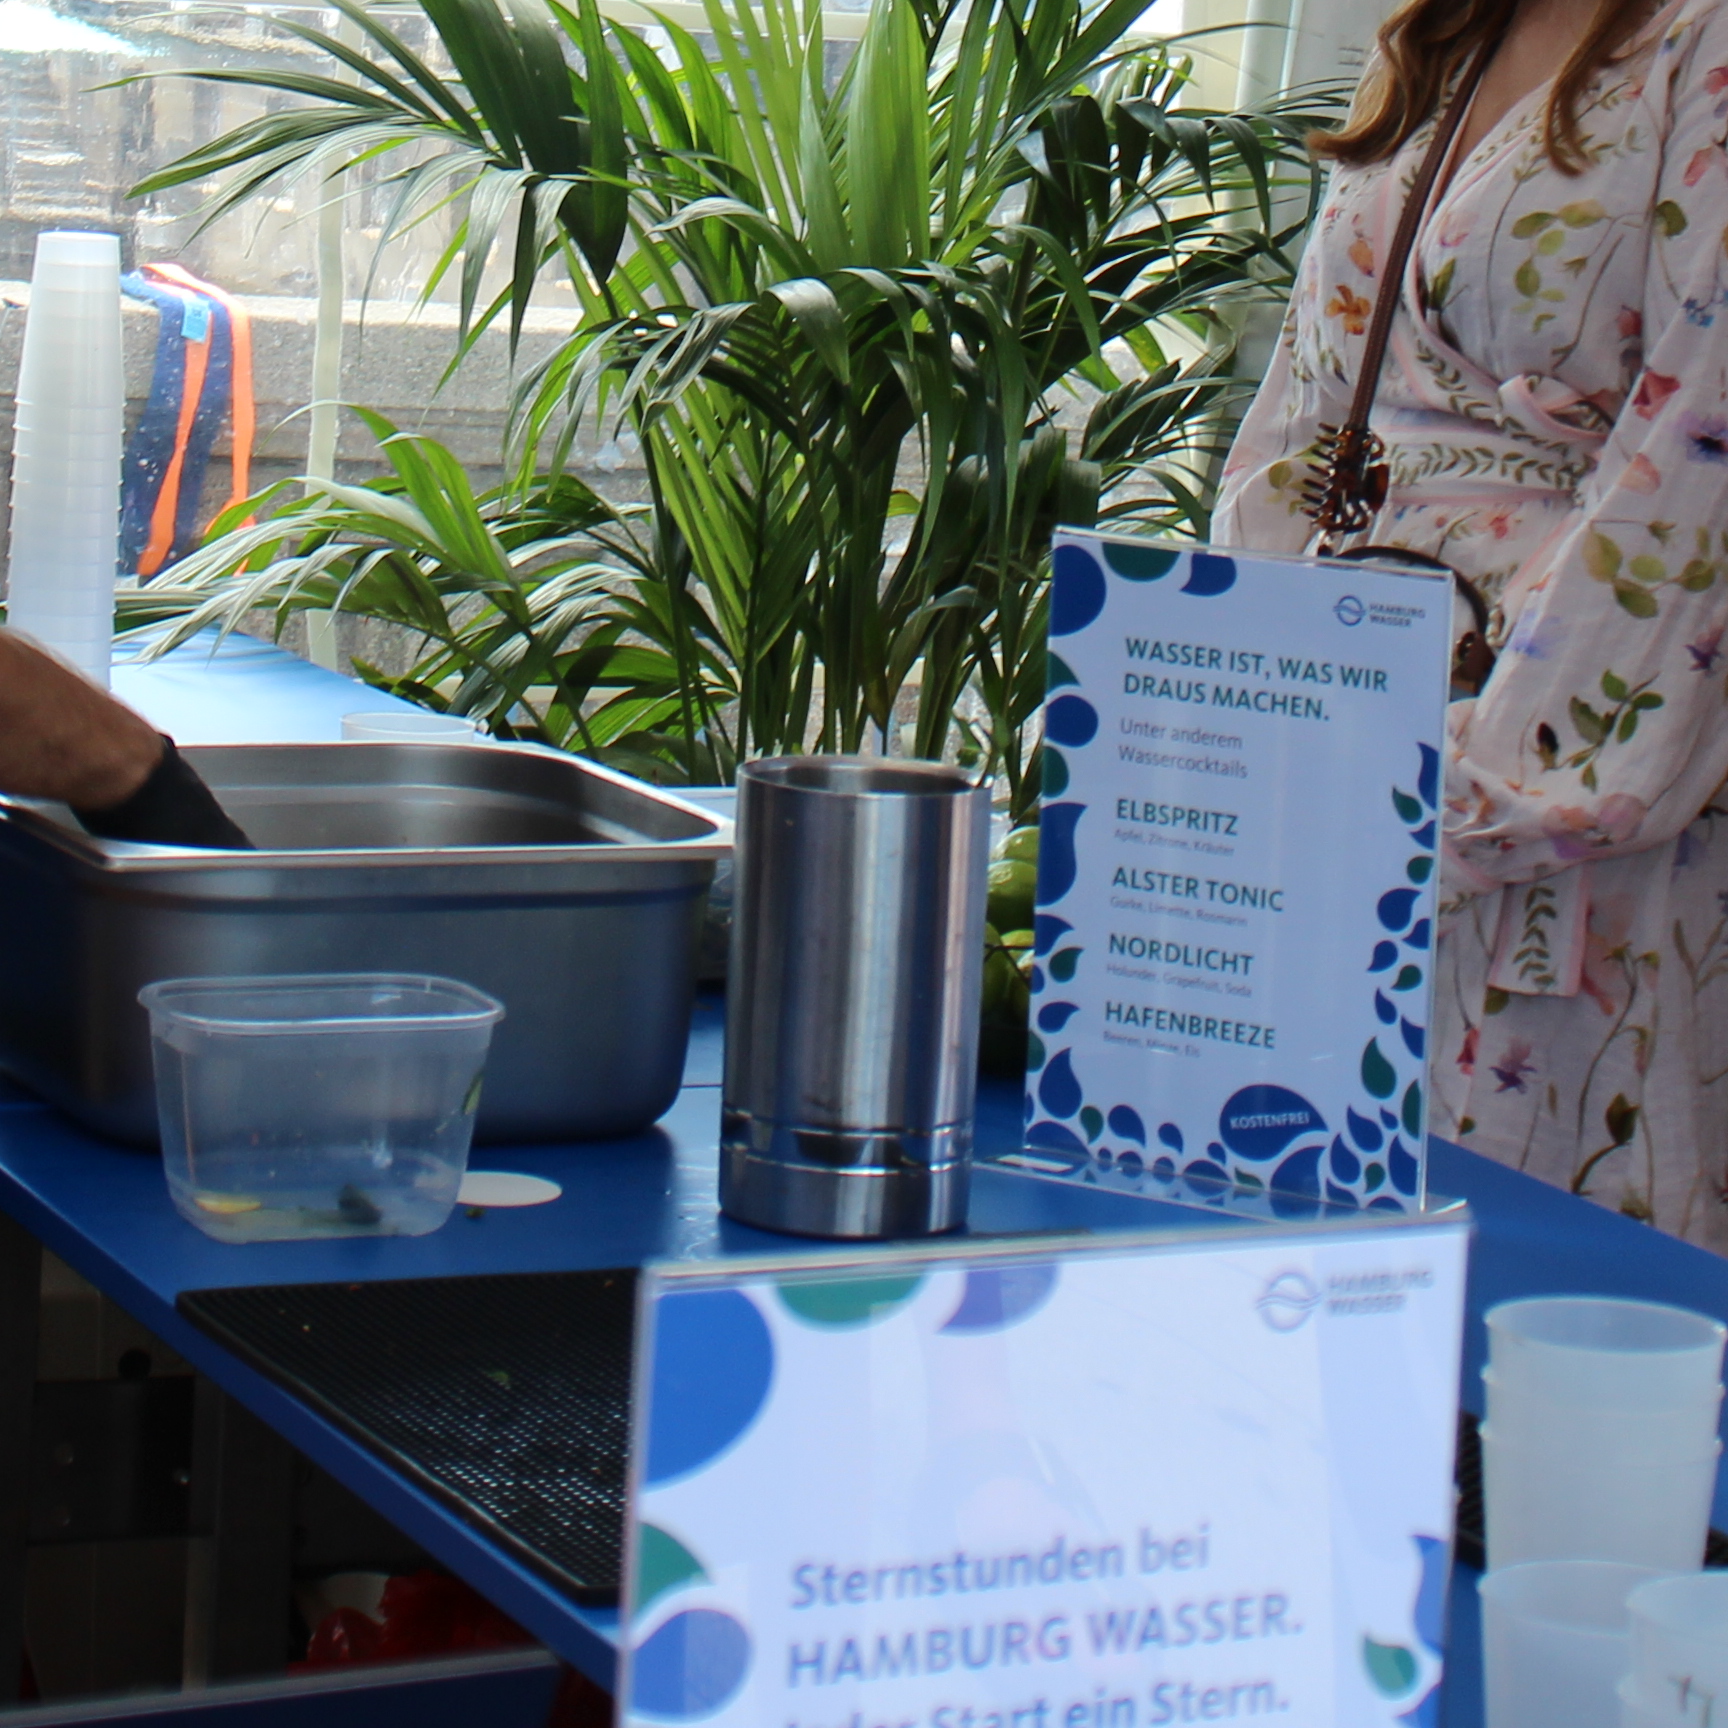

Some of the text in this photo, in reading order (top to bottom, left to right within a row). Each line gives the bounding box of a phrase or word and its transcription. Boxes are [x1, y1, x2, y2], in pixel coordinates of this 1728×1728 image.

[1125, 637, 1388, 692] WASSER IST, WAS WIR
[1124, 673, 1330, 721] DRAUS MACHEN.
[1120, 718, 1243, 749] Unter anderem
[1118, 745, 1249, 779] Wassercocktails
[1116, 798, 1238, 836] ELBSPRITZ
[1112, 867, 1284, 912] ALSTER TONIC
[1109, 933, 1255, 975] NORDLICHT
[1105, 1000, 1276, 1049] HAFENBREEZE
[1229, 1111, 1310, 1129] KOSTENFREI
[789, 1522, 1212, 1611] Sternstunden bei
[787, 1591, 1304, 1690] HAMBURG WASSER.
[1065, 1685, 1136, 1728] ein
[1150, 1680, 1292, 1726] Stern.
